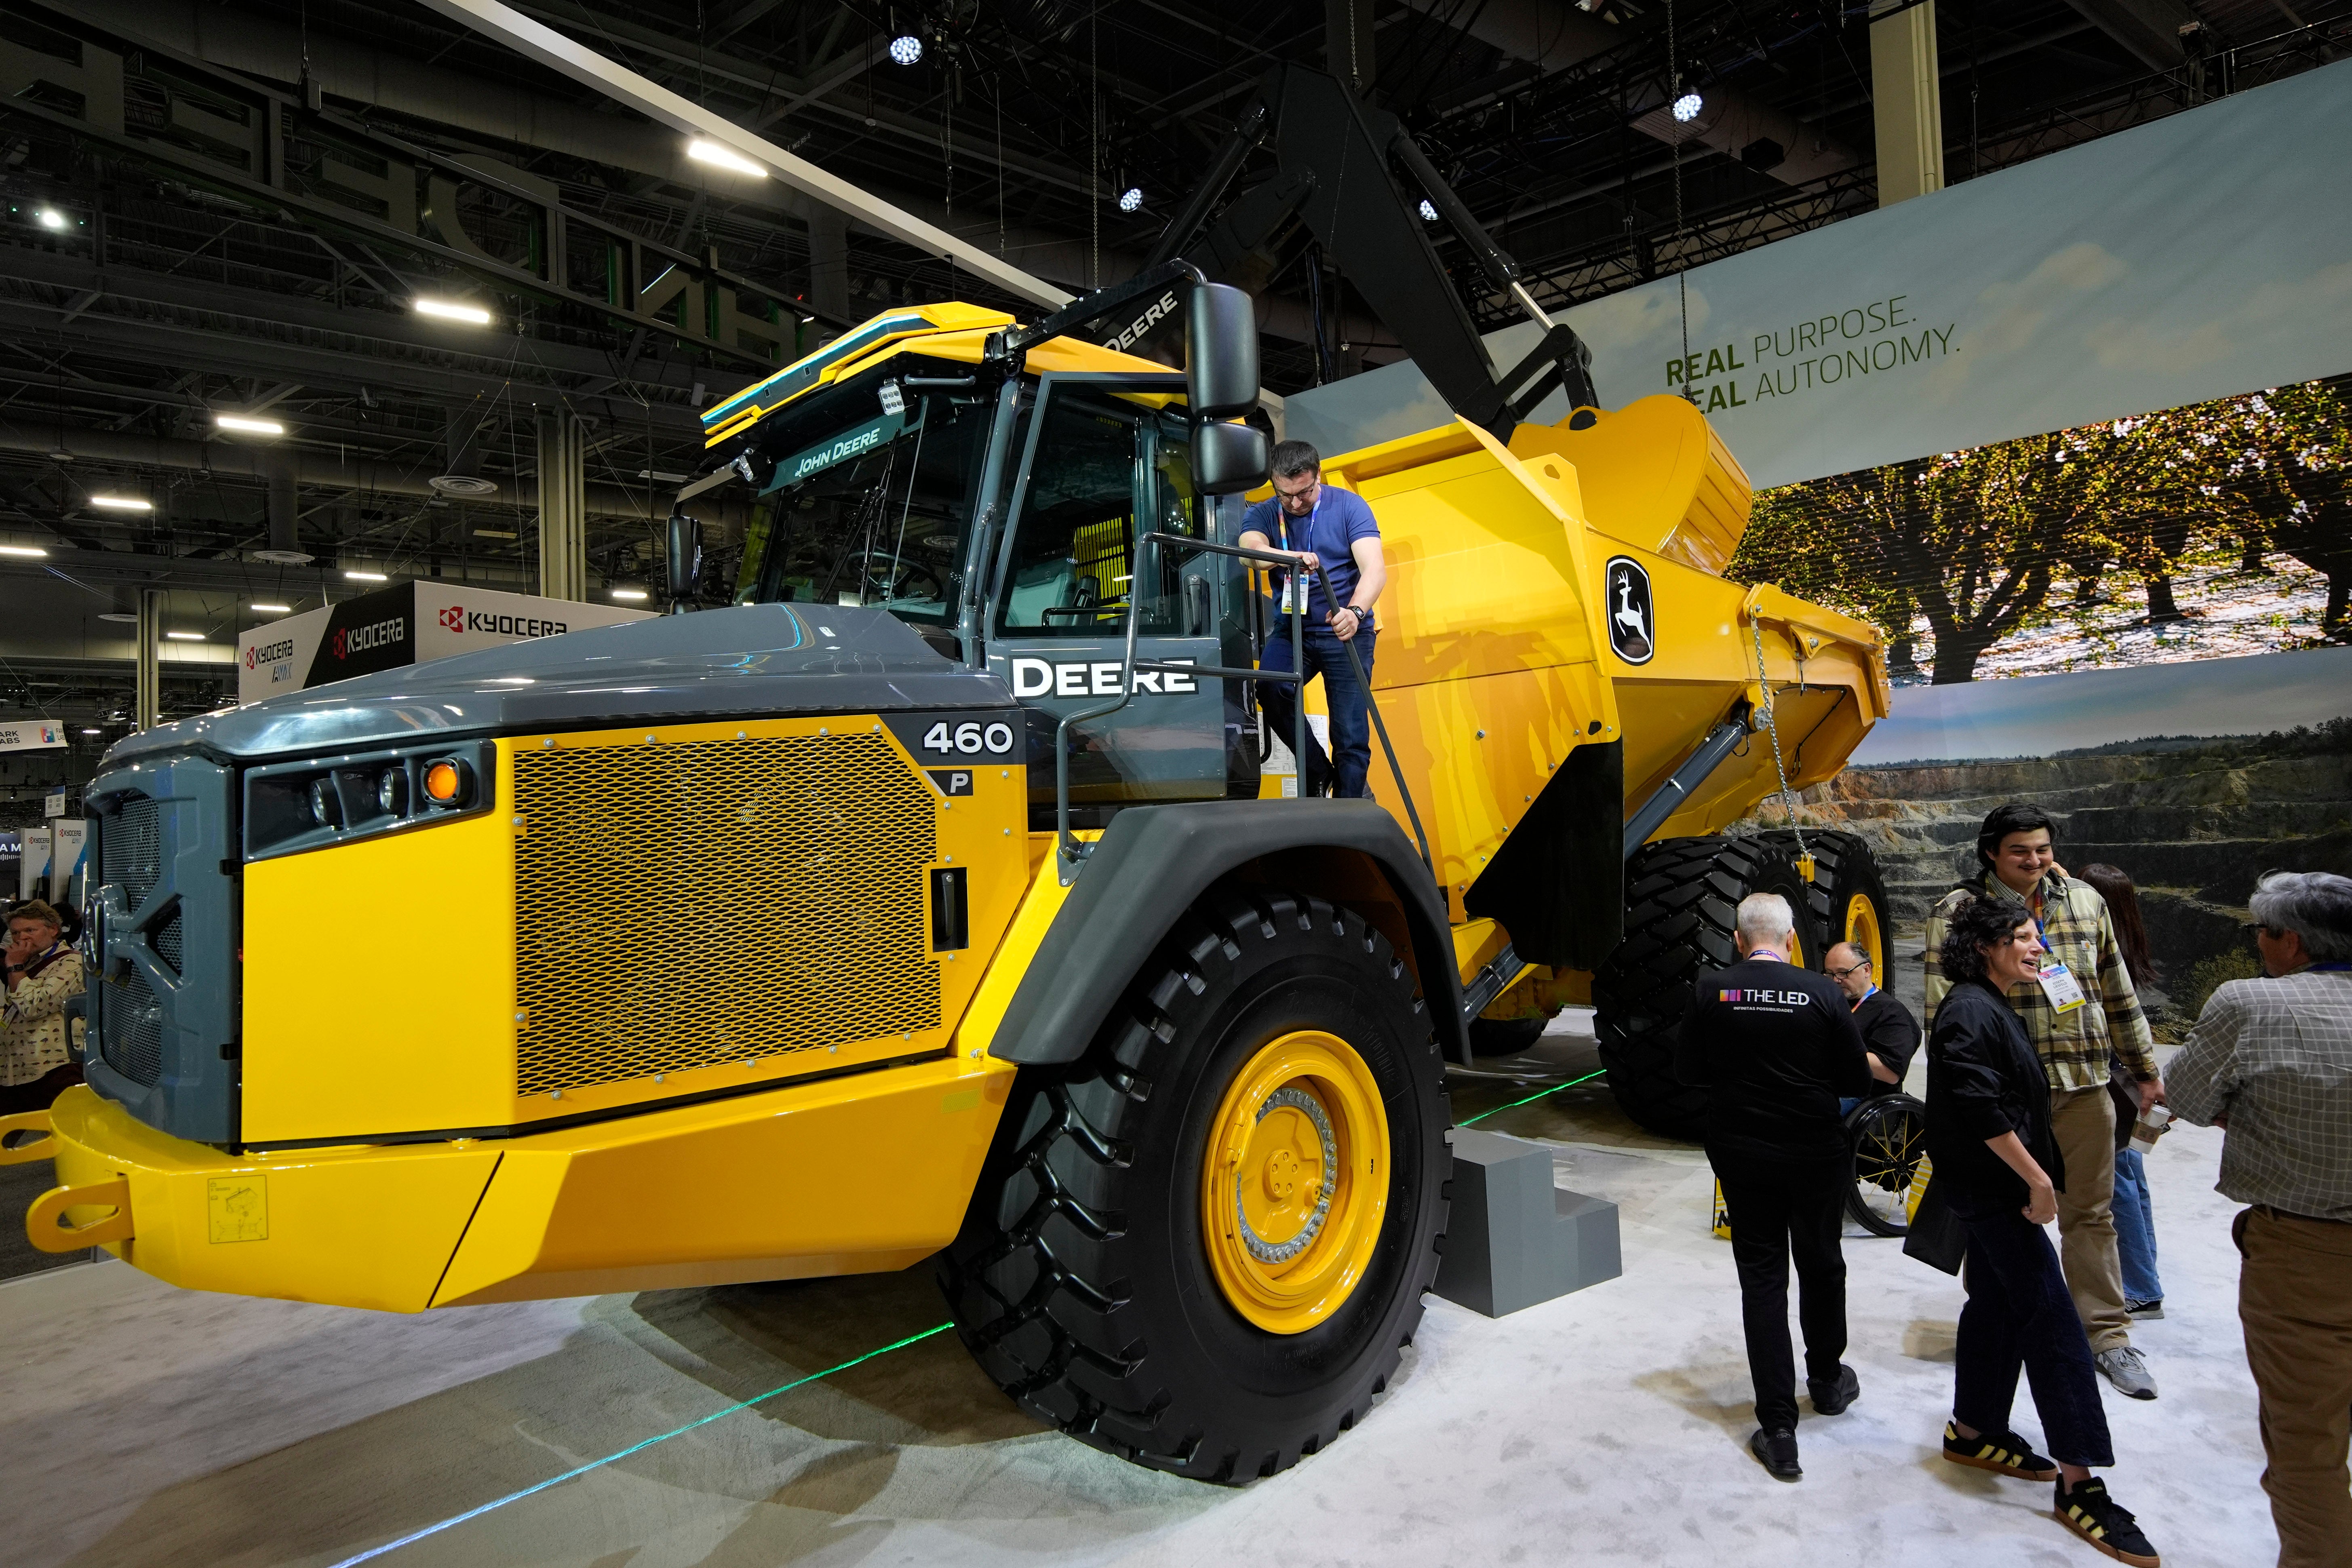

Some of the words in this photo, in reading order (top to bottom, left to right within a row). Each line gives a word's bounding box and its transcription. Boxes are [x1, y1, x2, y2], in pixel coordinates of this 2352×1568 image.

[1666, 344, 1745, 387] REAL
[1754, 295, 1917, 363] PURPOSE.
[1677, 381, 1746, 415] EAL
[1755, 323, 1960, 402] AUTONOMY.
[795, 449, 831, 477] JOHN
[832, 427, 881, 461] DEERE
[347, 617, 404, 654] KYOCERA
[468, 612, 567, 638] KYOCERA
[255, 639, 293, 665] KYOCERA
[1012, 658, 1196, 698] DEERE
[923, 723, 1014, 754] 460
[950, 773, 969, 794] P
[1744, 989, 1776, 1003] THE
[1779, 991, 1810, 1006] LED
